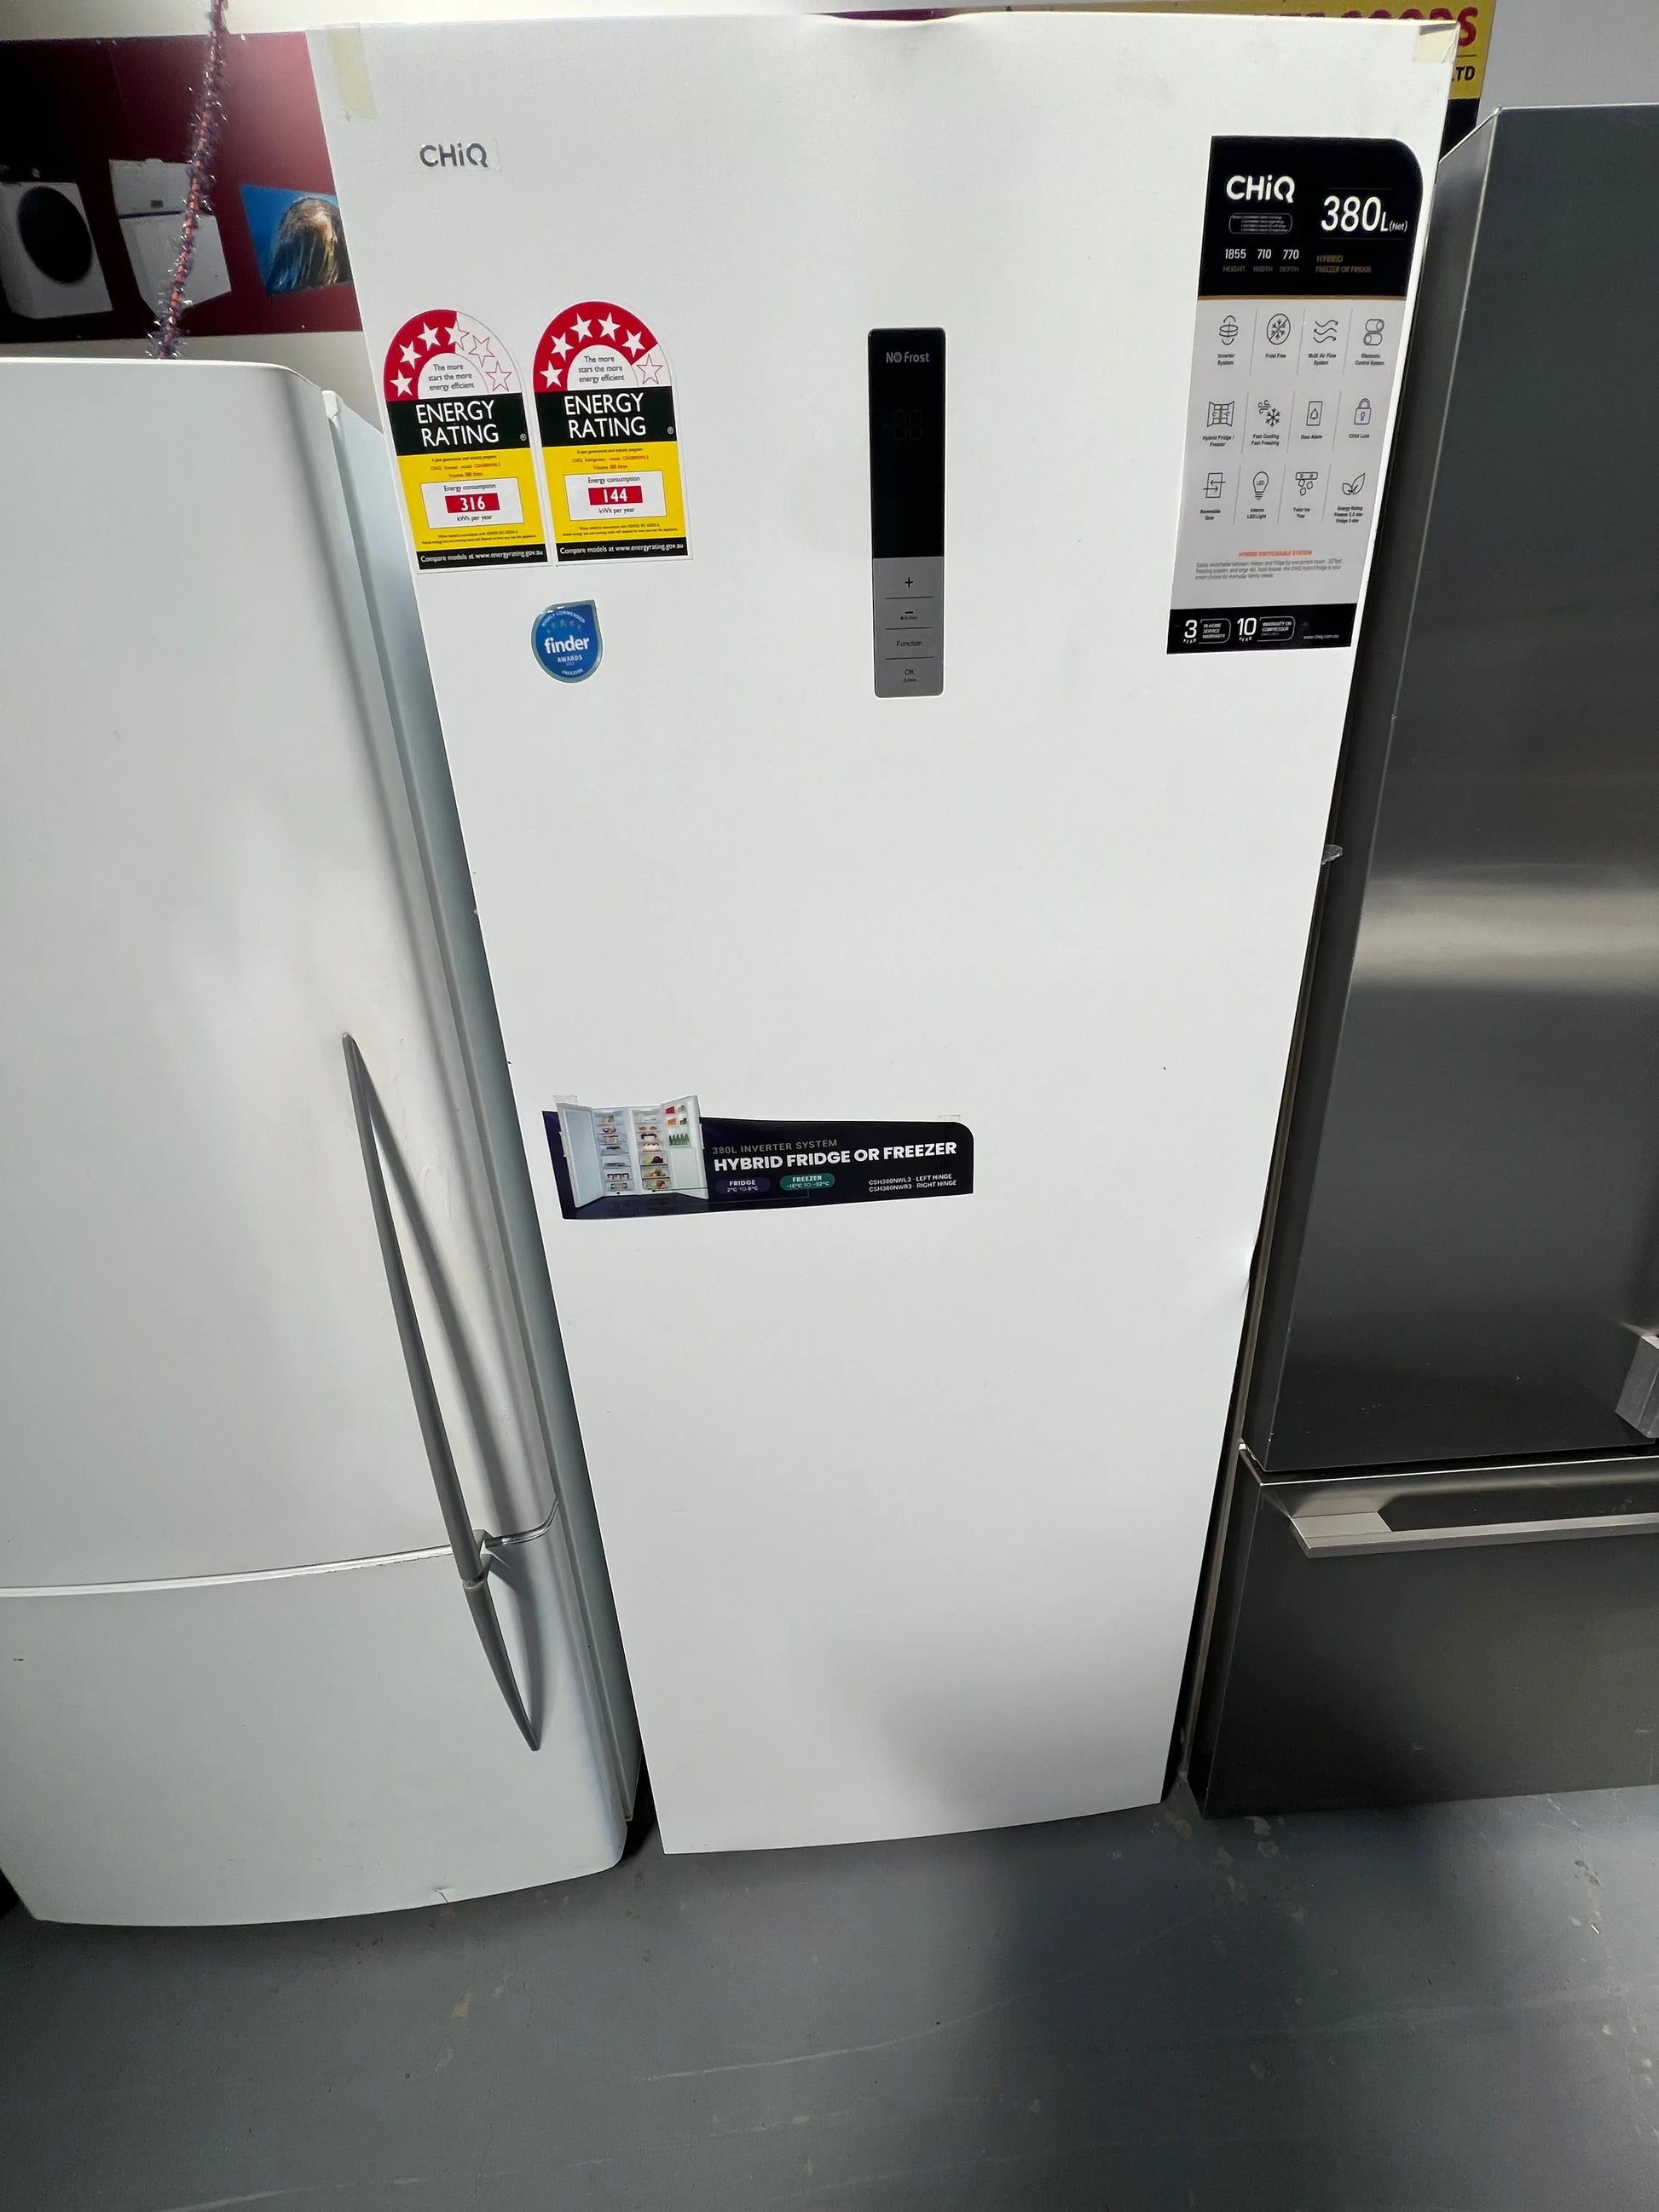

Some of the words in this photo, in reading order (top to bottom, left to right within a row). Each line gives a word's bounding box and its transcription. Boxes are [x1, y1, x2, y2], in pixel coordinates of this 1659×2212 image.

[1452, 66, 1476, 82] TD
[420, 142, 488, 168] CHiQ
[1227, 174, 1295, 203] CHiQ
[1225, 248, 1246, 259] 1855
[1257, 248, 1272, 259] 710
[1282, 249, 1299, 260] 770
[886, 351, 902, 363] NO
[416, 400, 494, 424] ENERGY
[564, 392, 644, 416] ENERGY
[568, 416, 646, 439] RATING
[421, 424, 500, 448] RATING
[444, 484, 461, 493] Energy
[603, 488, 627, 503] 144
[460, 495, 486, 511] 316
[616, 543, 684, 552] www.energyrating.gov.au
[420, 554, 447, 563] Compare
[475, 550, 544, 559] www.energyrating.gov.au
[1184, 620, 1198, 638] 3
[1237, 618, 1257, 636] 10
[544, 635, 589, 654] finder
[558, 655, 583, 663] AWARDS
[712, 1146, 737, 1155] 380L
[740, 1142, 792, 1153] INVERTER
[795, 1139, 837, 1149] SYSTEM
[714, 1155, 783, 1171] HYBRID
[787, 1150, 851, 1168] FRIDGE
[853, 1148, 880, 1162] OR
[883, 1141, 957, 1160] FREEZER
